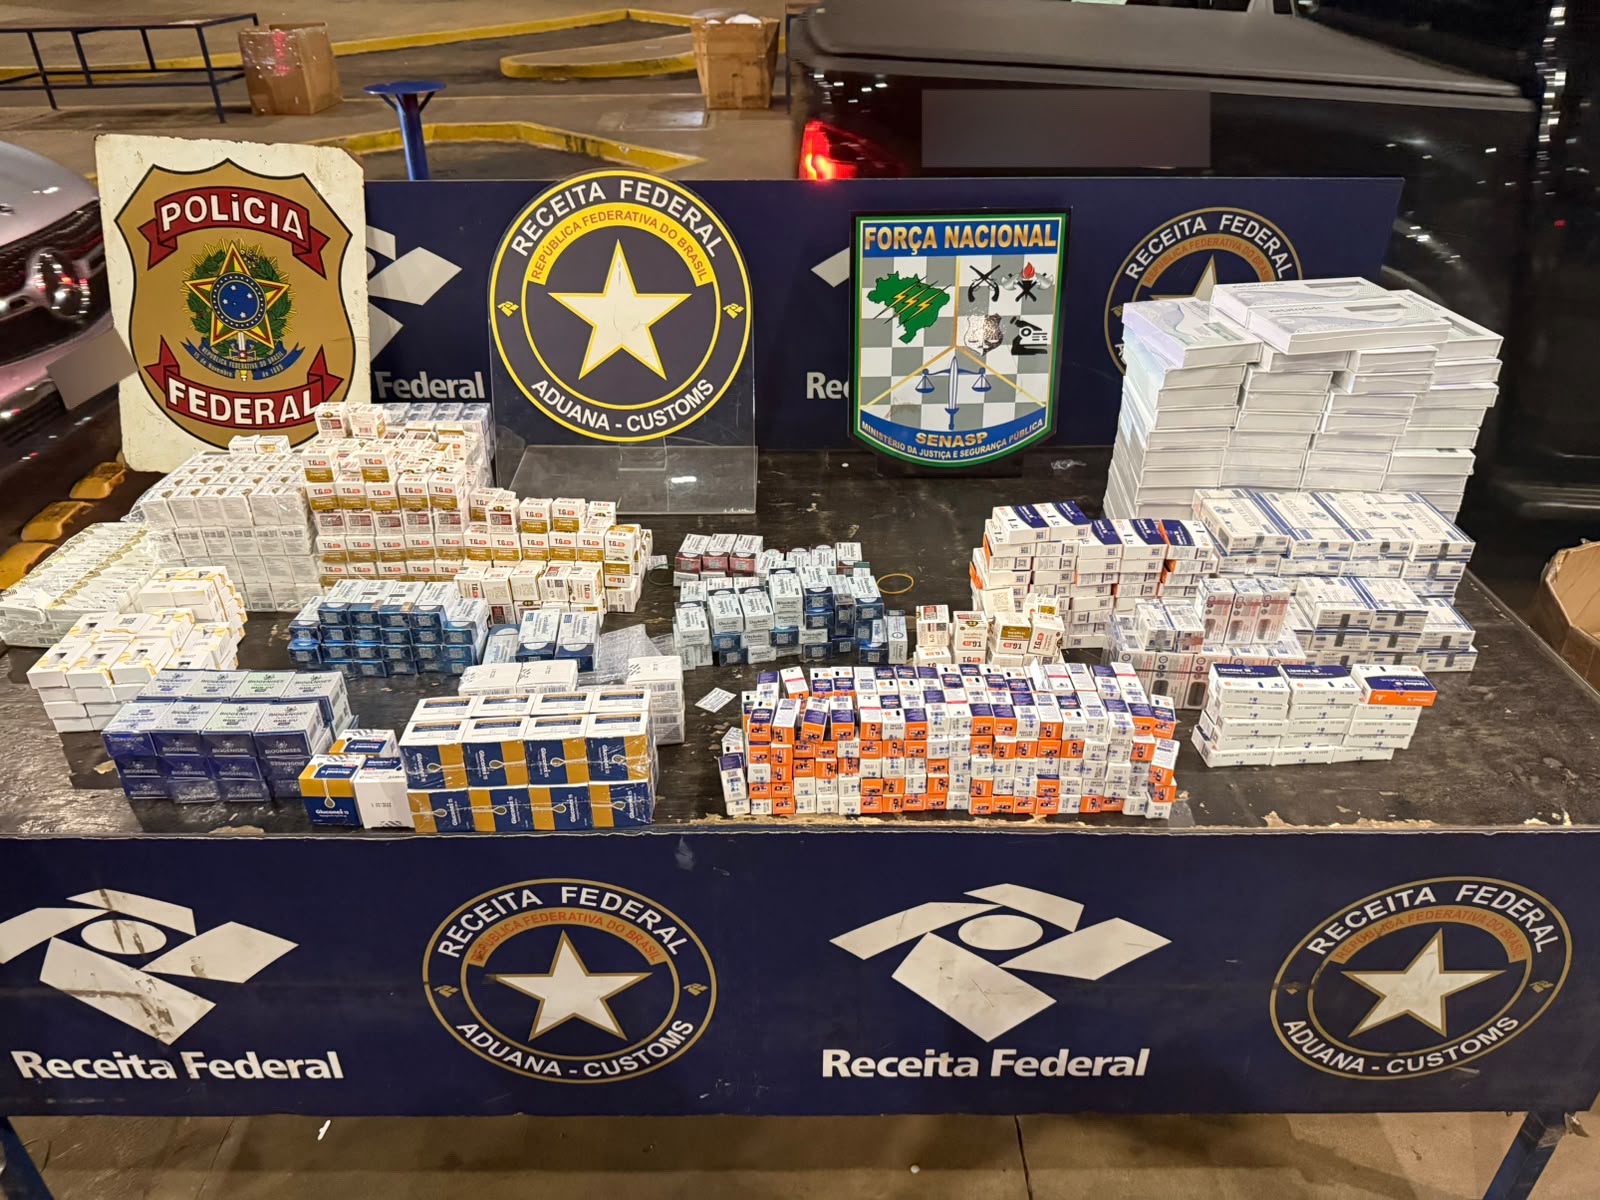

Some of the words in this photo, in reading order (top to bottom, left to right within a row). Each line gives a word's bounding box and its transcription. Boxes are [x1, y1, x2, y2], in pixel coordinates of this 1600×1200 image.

[512, 181, 606, 256] RECEITA
[620, 179, 723, 258] FEDERAL
[864, 226, 938, 256] FORÇA
[944, 223, 1056, 249] NACIONAL
[531, 222, 582, 280] REPÚBLICA
[582, 210, 658, 228] FEDERATIVA
[659, 224, 678, 240] DO
[678, 235, 707, 281] BRASIL
[1125, 216, 1208, 280] RECEITA
[1219, 214, 1294, 279] FEDERAL
[167, 376, 316, 426] FEDERAL
[375, 371, 484, 400] Federal
[532, 378, 610, 432] ADUANA
[626, 378, 714, 432] CUSTOMS
[862, 420, 906, 452] MINISTÉRIO
[907, 446, 918, 455] DA
[919, 448, 952, 460] JUSTIÇA
[952, 450, 958, 458] E
[959, 438, 1006, 458] SEGURANÇA
[1008, 418, 1044, 442] PÚBLICA
[916, 432, 988, 448] SENASP
[438, 888, 543, 958] RECEITA
[561, 886, 690, 956] FEDERAL
[522, 910, 604, 927] FEDERATIVA
[606, 920, 625, 934] DO
[626, 928, 660, 962] BRASIL
[1306, 886, 1436, 956] RECEITA
[1455, 884, 1560, 954] FEDERAL
[1407, 909, 1487, 926] FEDERATIVA
[1486, 917, 1501, 930] DO
[1500, 926, 1526, 960] BRASIL
[10, 1050, 178, 1080] Receita
[180, 1051, 344, 1080] Federal
[456, 1022, 562, 1076] ADUANA
[584, 1020, 695, 1077] CUSTOMS
[822, 1048, 978, 1078] Receita
[990, 1048, 1150, 1077] Federal
[1283, 1020, 1366, 1073] ADUANA
[1386, 1016, 1520, 1074] CUSTOMS
